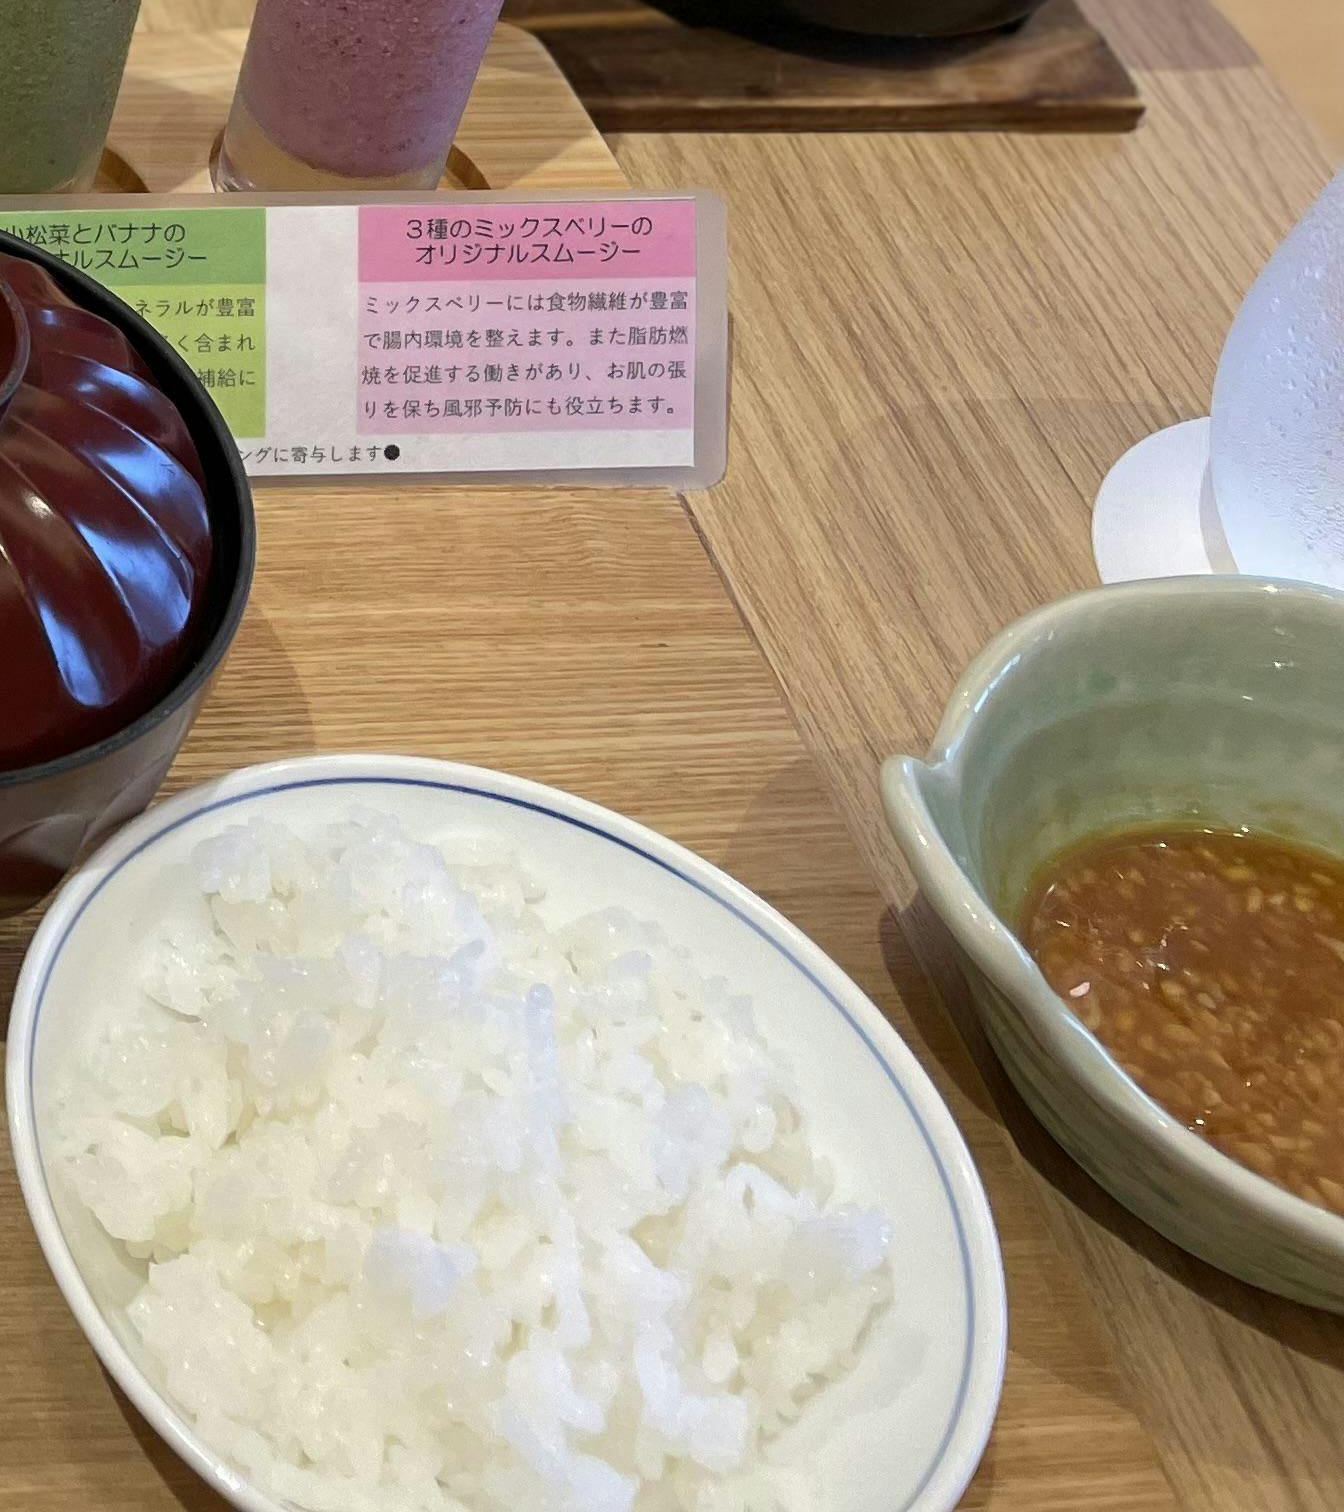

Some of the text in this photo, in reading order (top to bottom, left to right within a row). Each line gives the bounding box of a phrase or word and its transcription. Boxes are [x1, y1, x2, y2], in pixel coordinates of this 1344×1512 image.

[406, 216, 653, 239] 3種のミックスベリーの
[416, 241, 641, 265] オリジナルスムージー
[161, 331, 255, 354] く含まれ
[361, 360, 688, 384] 焼を促進する働きがあり、お肌の張
[364, 395, 675, 419] りを保ち風邪予防にも役立ちます。
